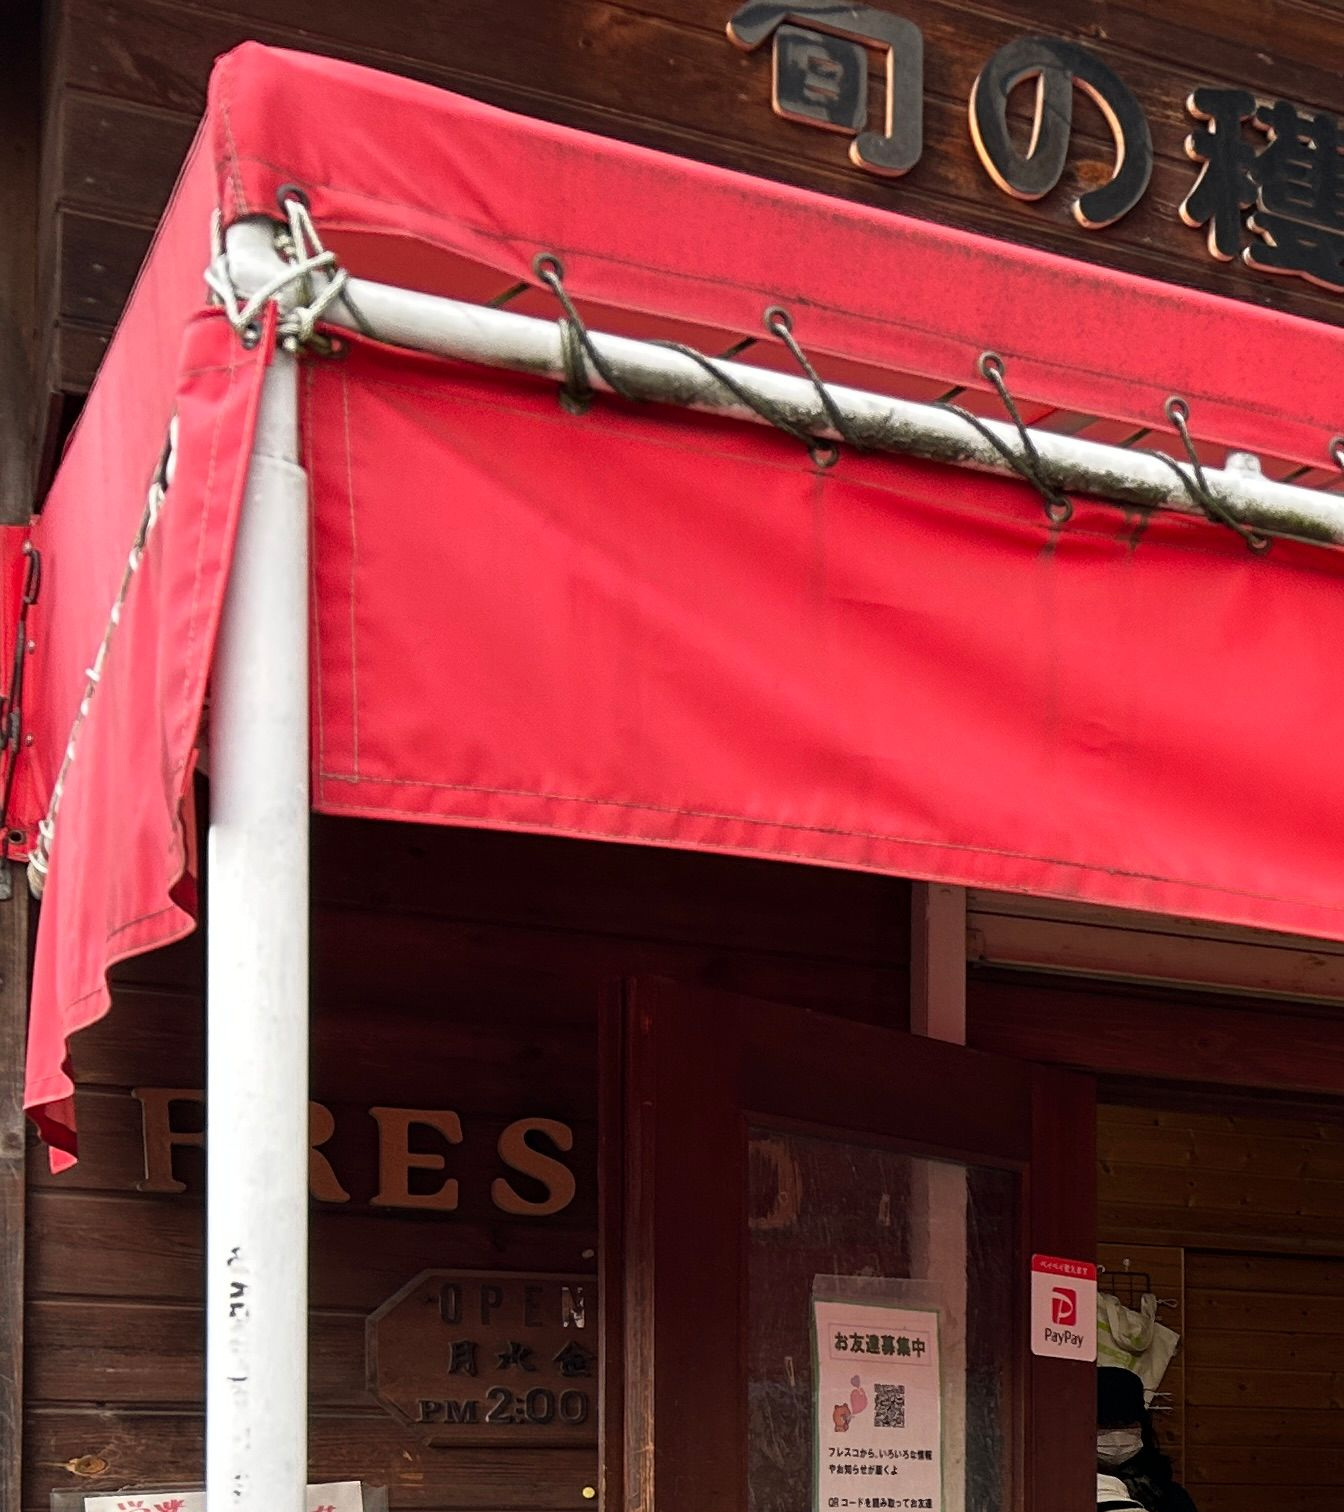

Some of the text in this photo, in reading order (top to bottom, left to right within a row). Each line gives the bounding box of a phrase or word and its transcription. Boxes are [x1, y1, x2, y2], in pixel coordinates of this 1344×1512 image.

[438, 1283, 586, 1329] OPEN
[834, 1331, 926, 1359] お友達募集中
[1044, 1327, 1084, 1348] PayPay
